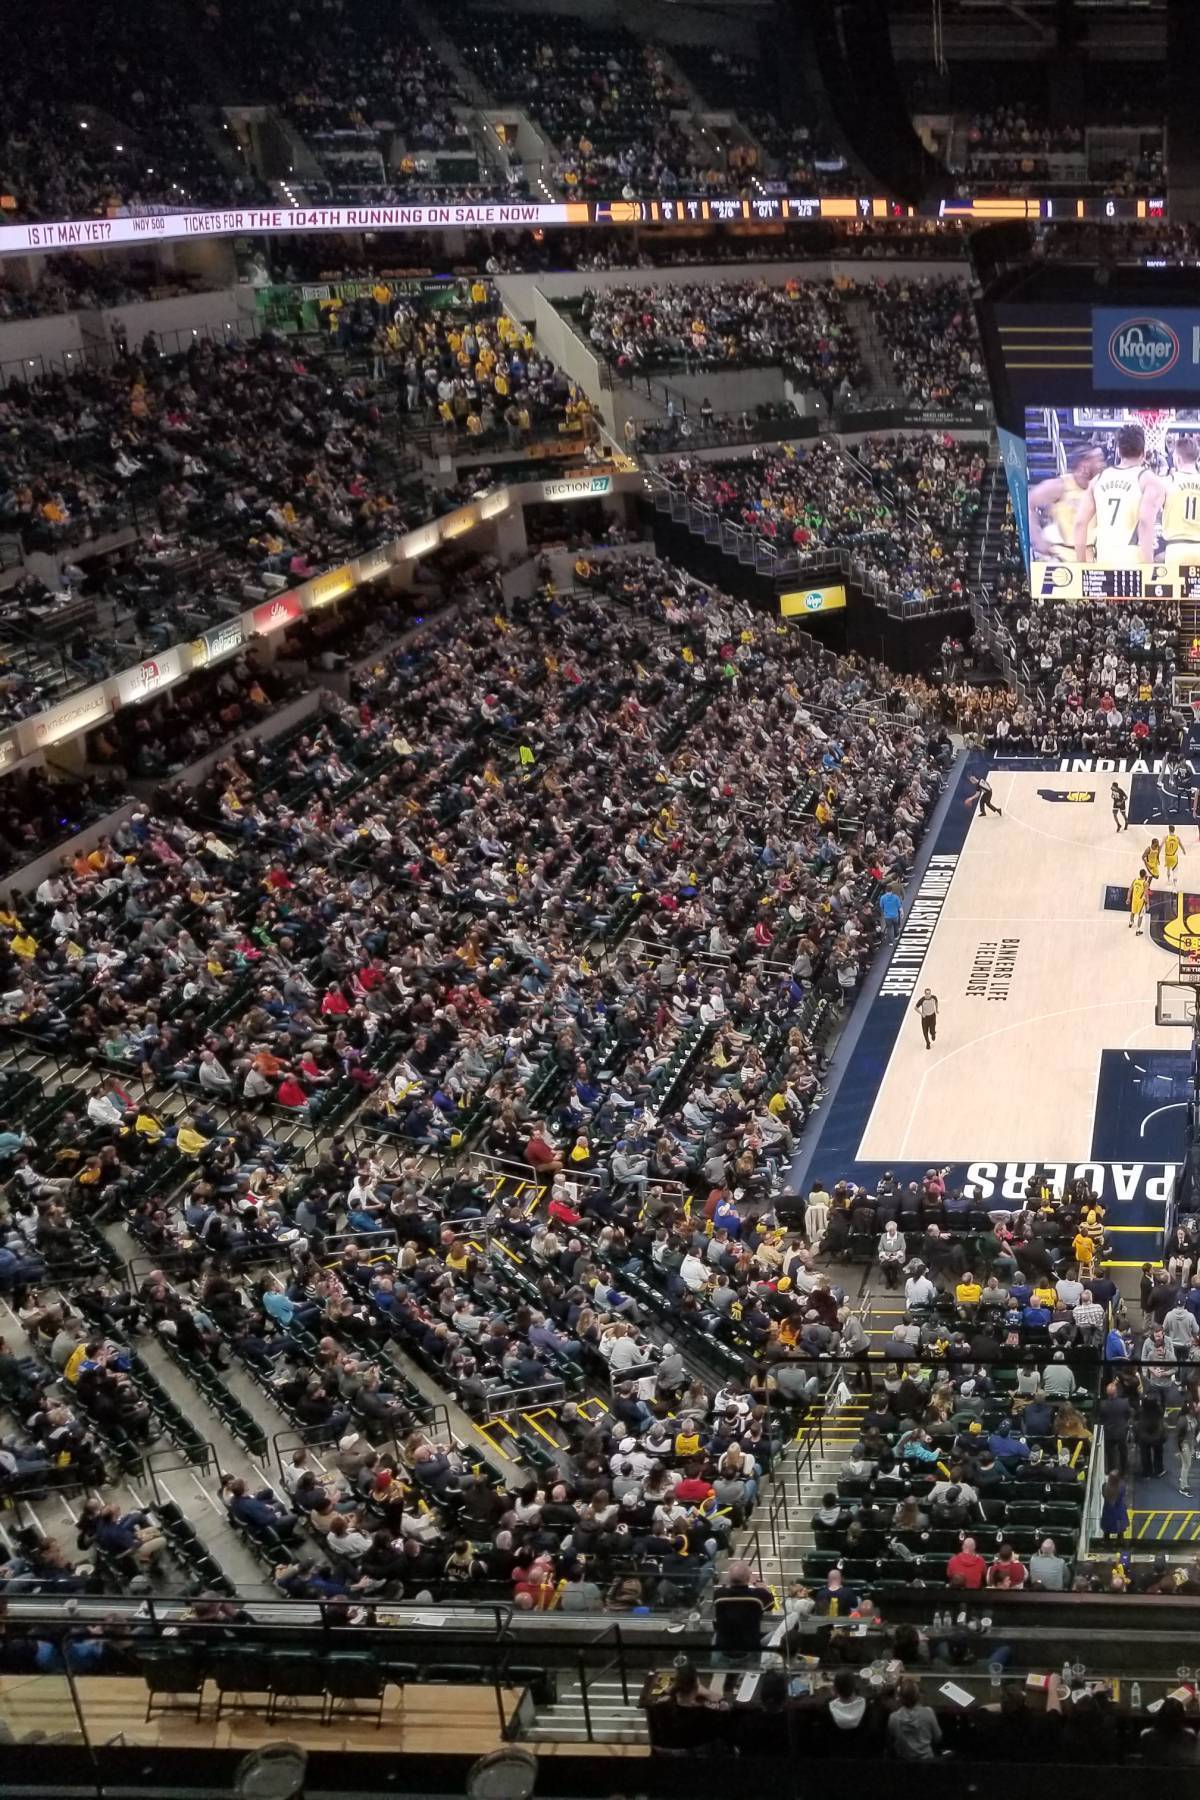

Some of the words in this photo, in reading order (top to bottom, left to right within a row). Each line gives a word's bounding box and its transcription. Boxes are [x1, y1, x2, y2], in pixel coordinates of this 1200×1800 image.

[184, 215, 222, 232] TICKETS
[223, 213, 243, 229] FOR
[248, 212, 282, 227] THE
[288, 211, 340, 226] 104TH
[346, 209, 422, 225] RUNNING
[428, 208, 450, 223] ON
[455, 207, 495, 222] SALE
[500, 206, 540, 222] NOW!
[1106, 201, 1115, 216] 6
[27, 227, 40, 246] IS
[44, 226, 54, 244] IT
[57, 224, 82, 243] MAY
[83, 223, 112, 241] YET?
[1119, 328, 1172, 370] Kroger
[545, 482, 590, 496] SECTION
[592, 479, 607, 490] 127
[1107, 498, 1121, 527] 7
[1184, 496, 1197, 520] 11
[1154, 585, 1163, 596] 6
[211, 629, 242, 653] @Pacers
[929, 854, 960, 868] WE
[917, 870, 954, 897] GROW
[891, 899, 944, 964] BASKETBALL
[965, 942, 998, 997] FIELDHOUSE
[993, 938, 1020, 979] BANKERS
[879, 967, 920, 997] HERE
[987, 982, 1011, 1001] LIFE
